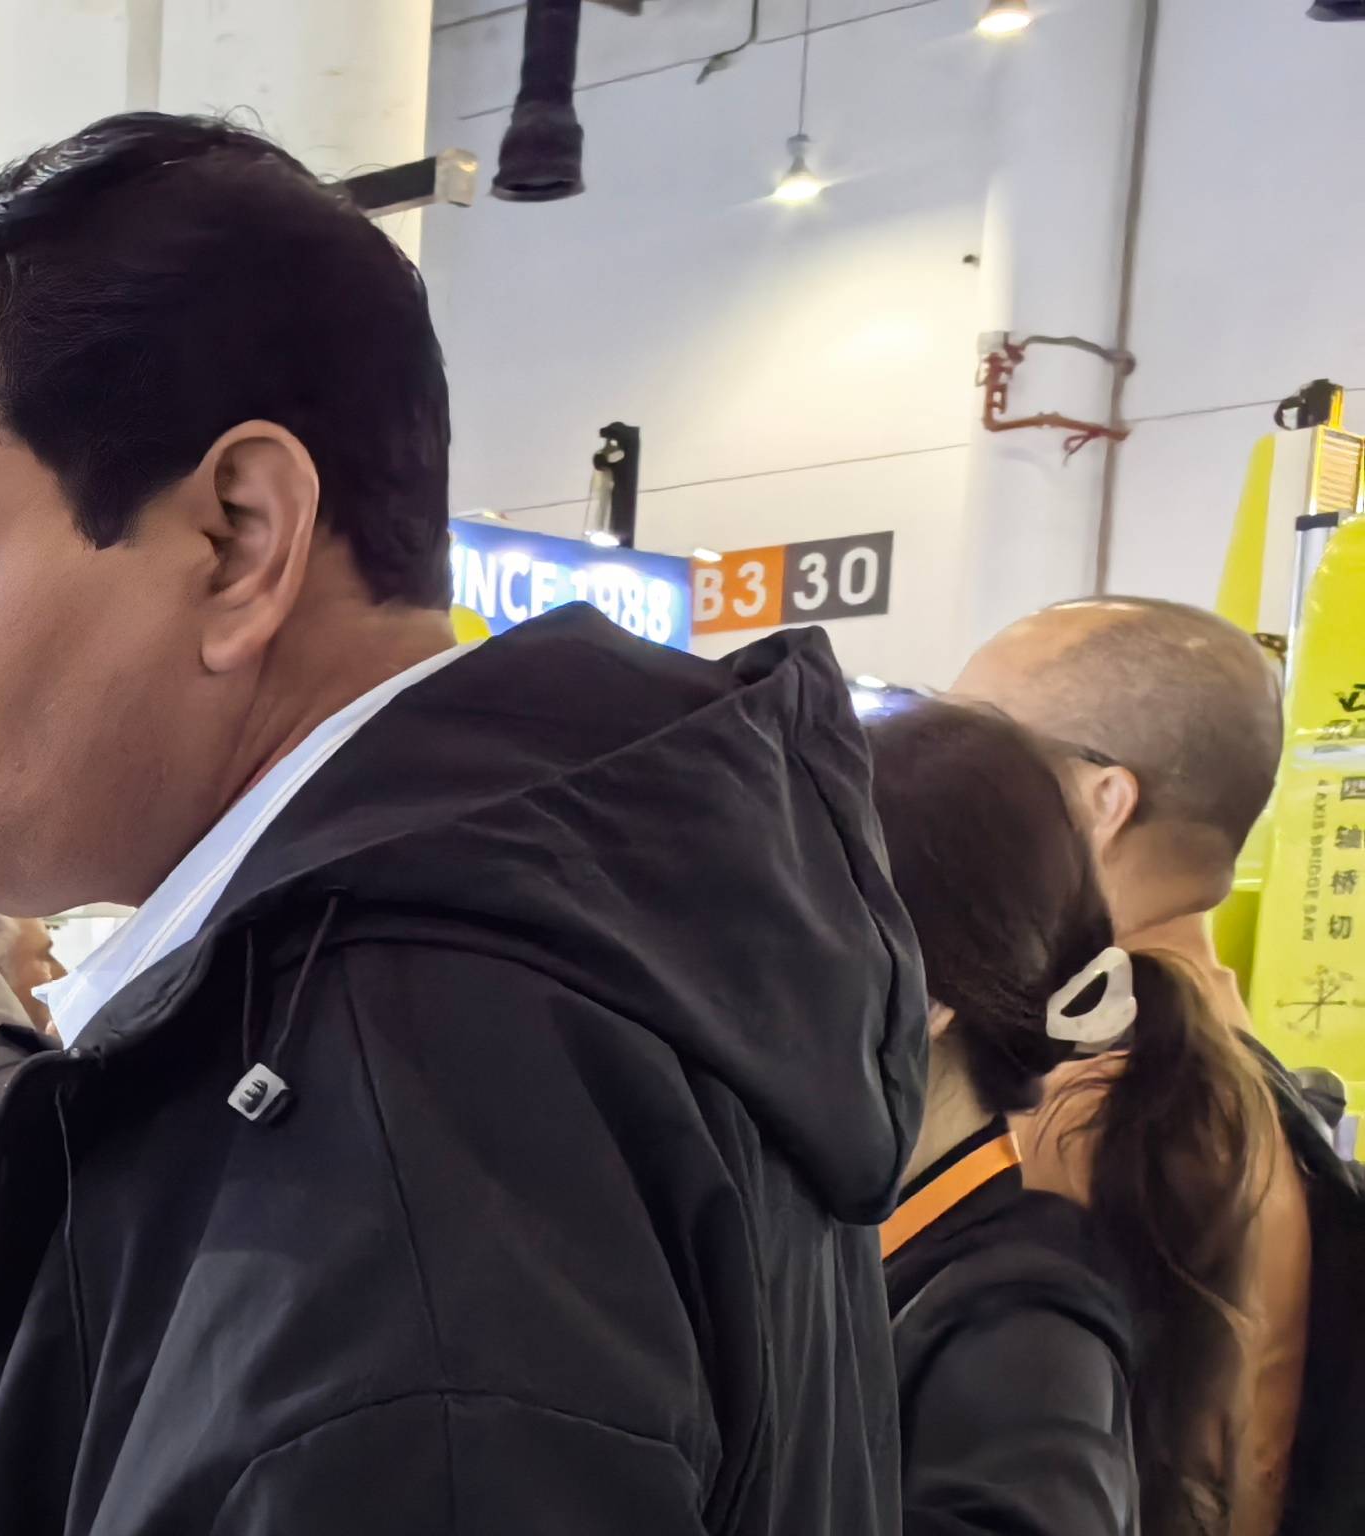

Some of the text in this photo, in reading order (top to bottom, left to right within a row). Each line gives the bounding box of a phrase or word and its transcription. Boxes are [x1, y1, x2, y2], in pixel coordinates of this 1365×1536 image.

[451, 545, 672, 645] INCE 1988
[694, 547, 879, 622] B3 30
